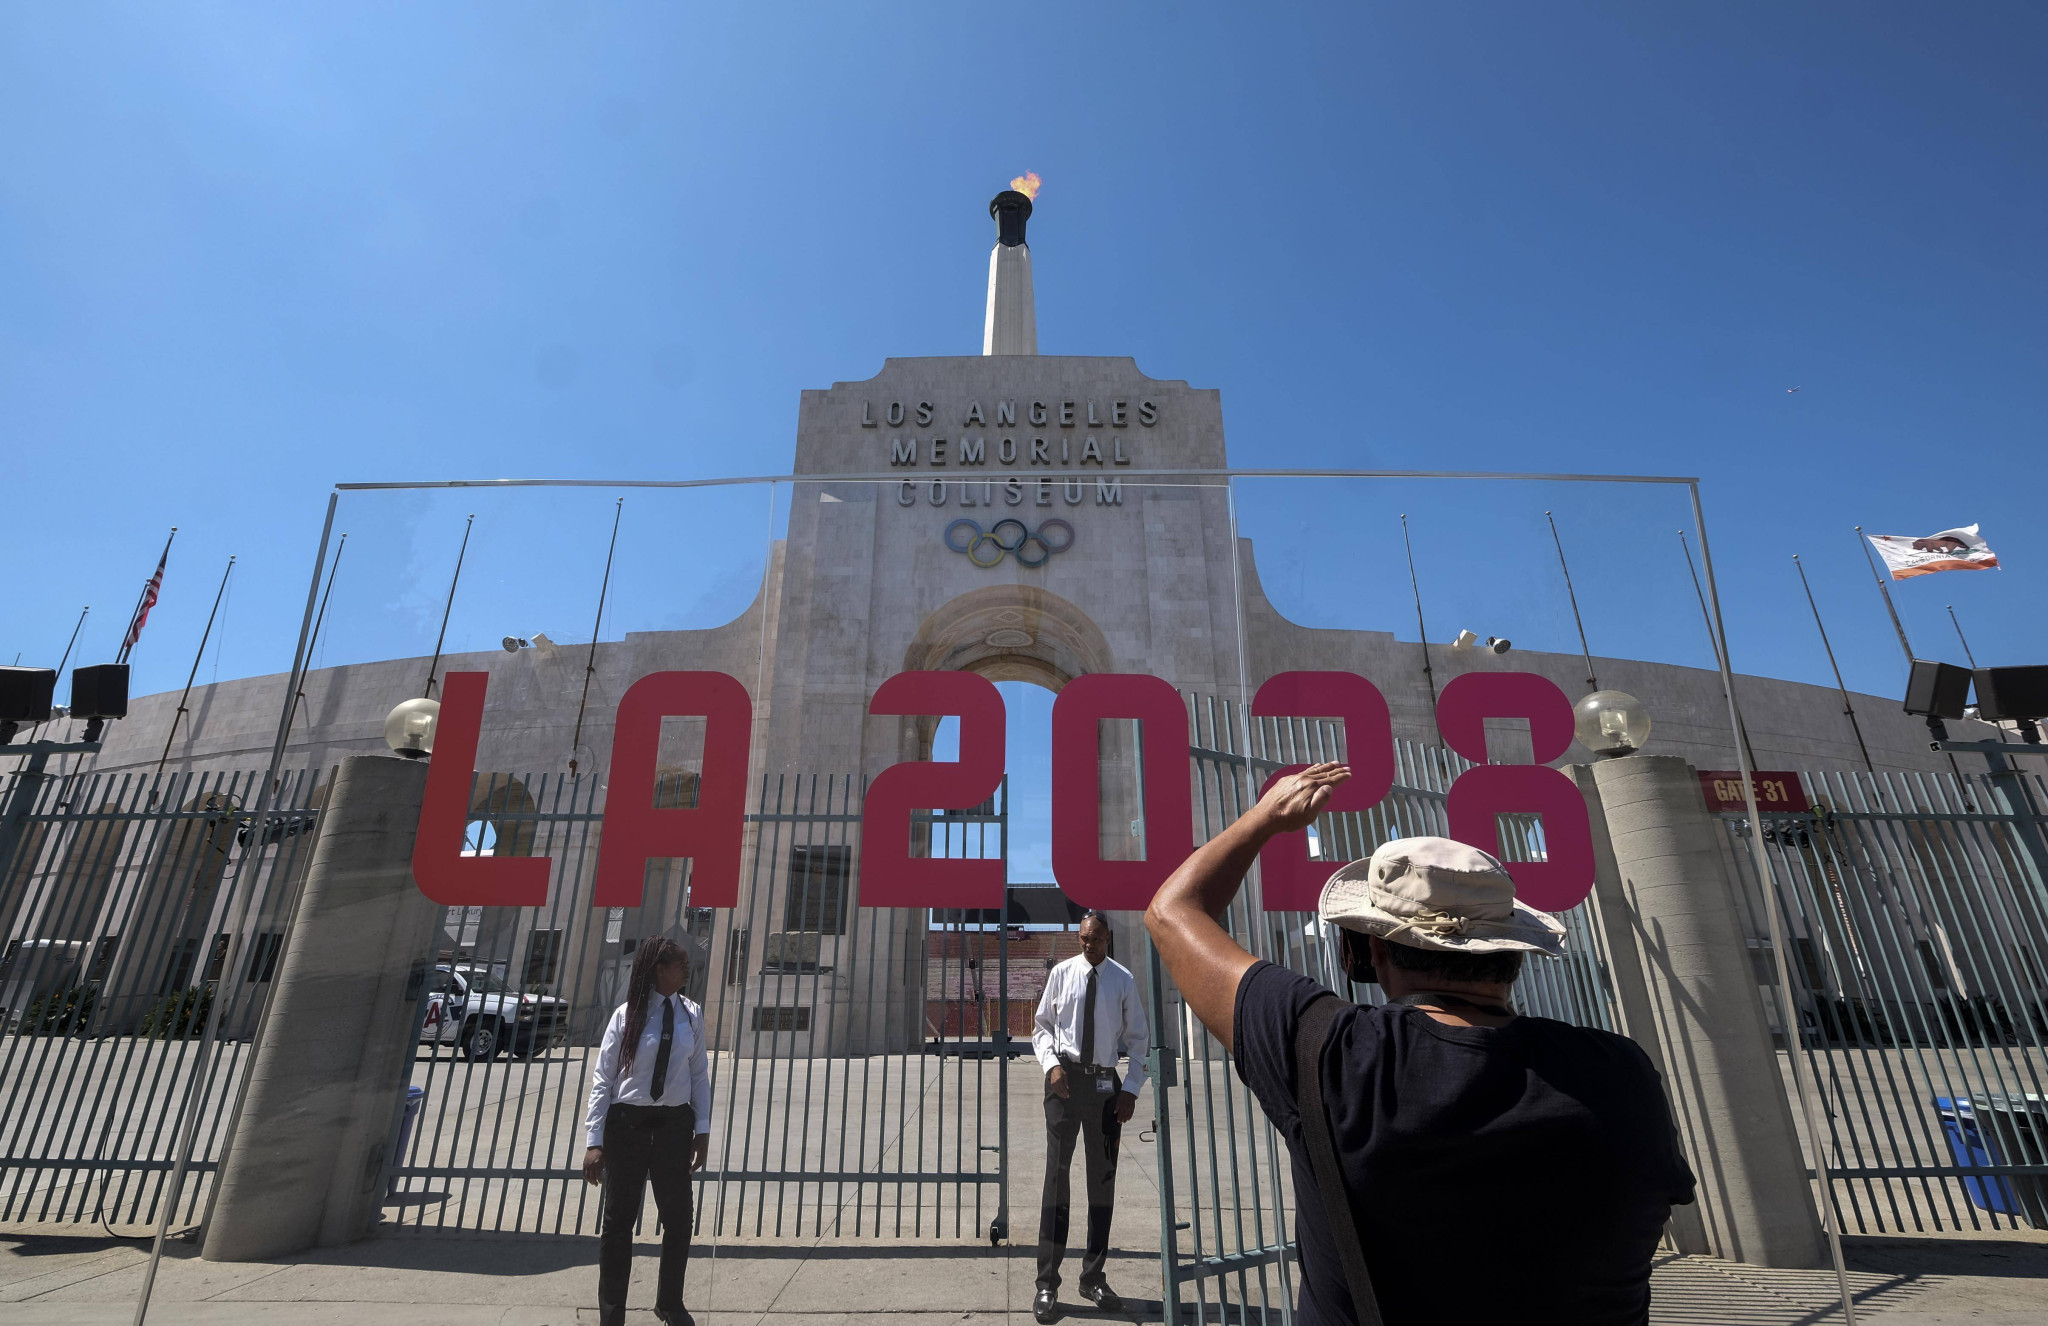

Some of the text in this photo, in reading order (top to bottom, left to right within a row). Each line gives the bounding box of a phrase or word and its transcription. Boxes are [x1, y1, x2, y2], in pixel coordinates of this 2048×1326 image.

[861, 398, 1158, 428] LOS ANGELES
[890, 435, 1130, 466] MEMORIAL
[897, 477, 1123, 508] COLISEUM
[1713, 779, 1789, 802] GATE 31
